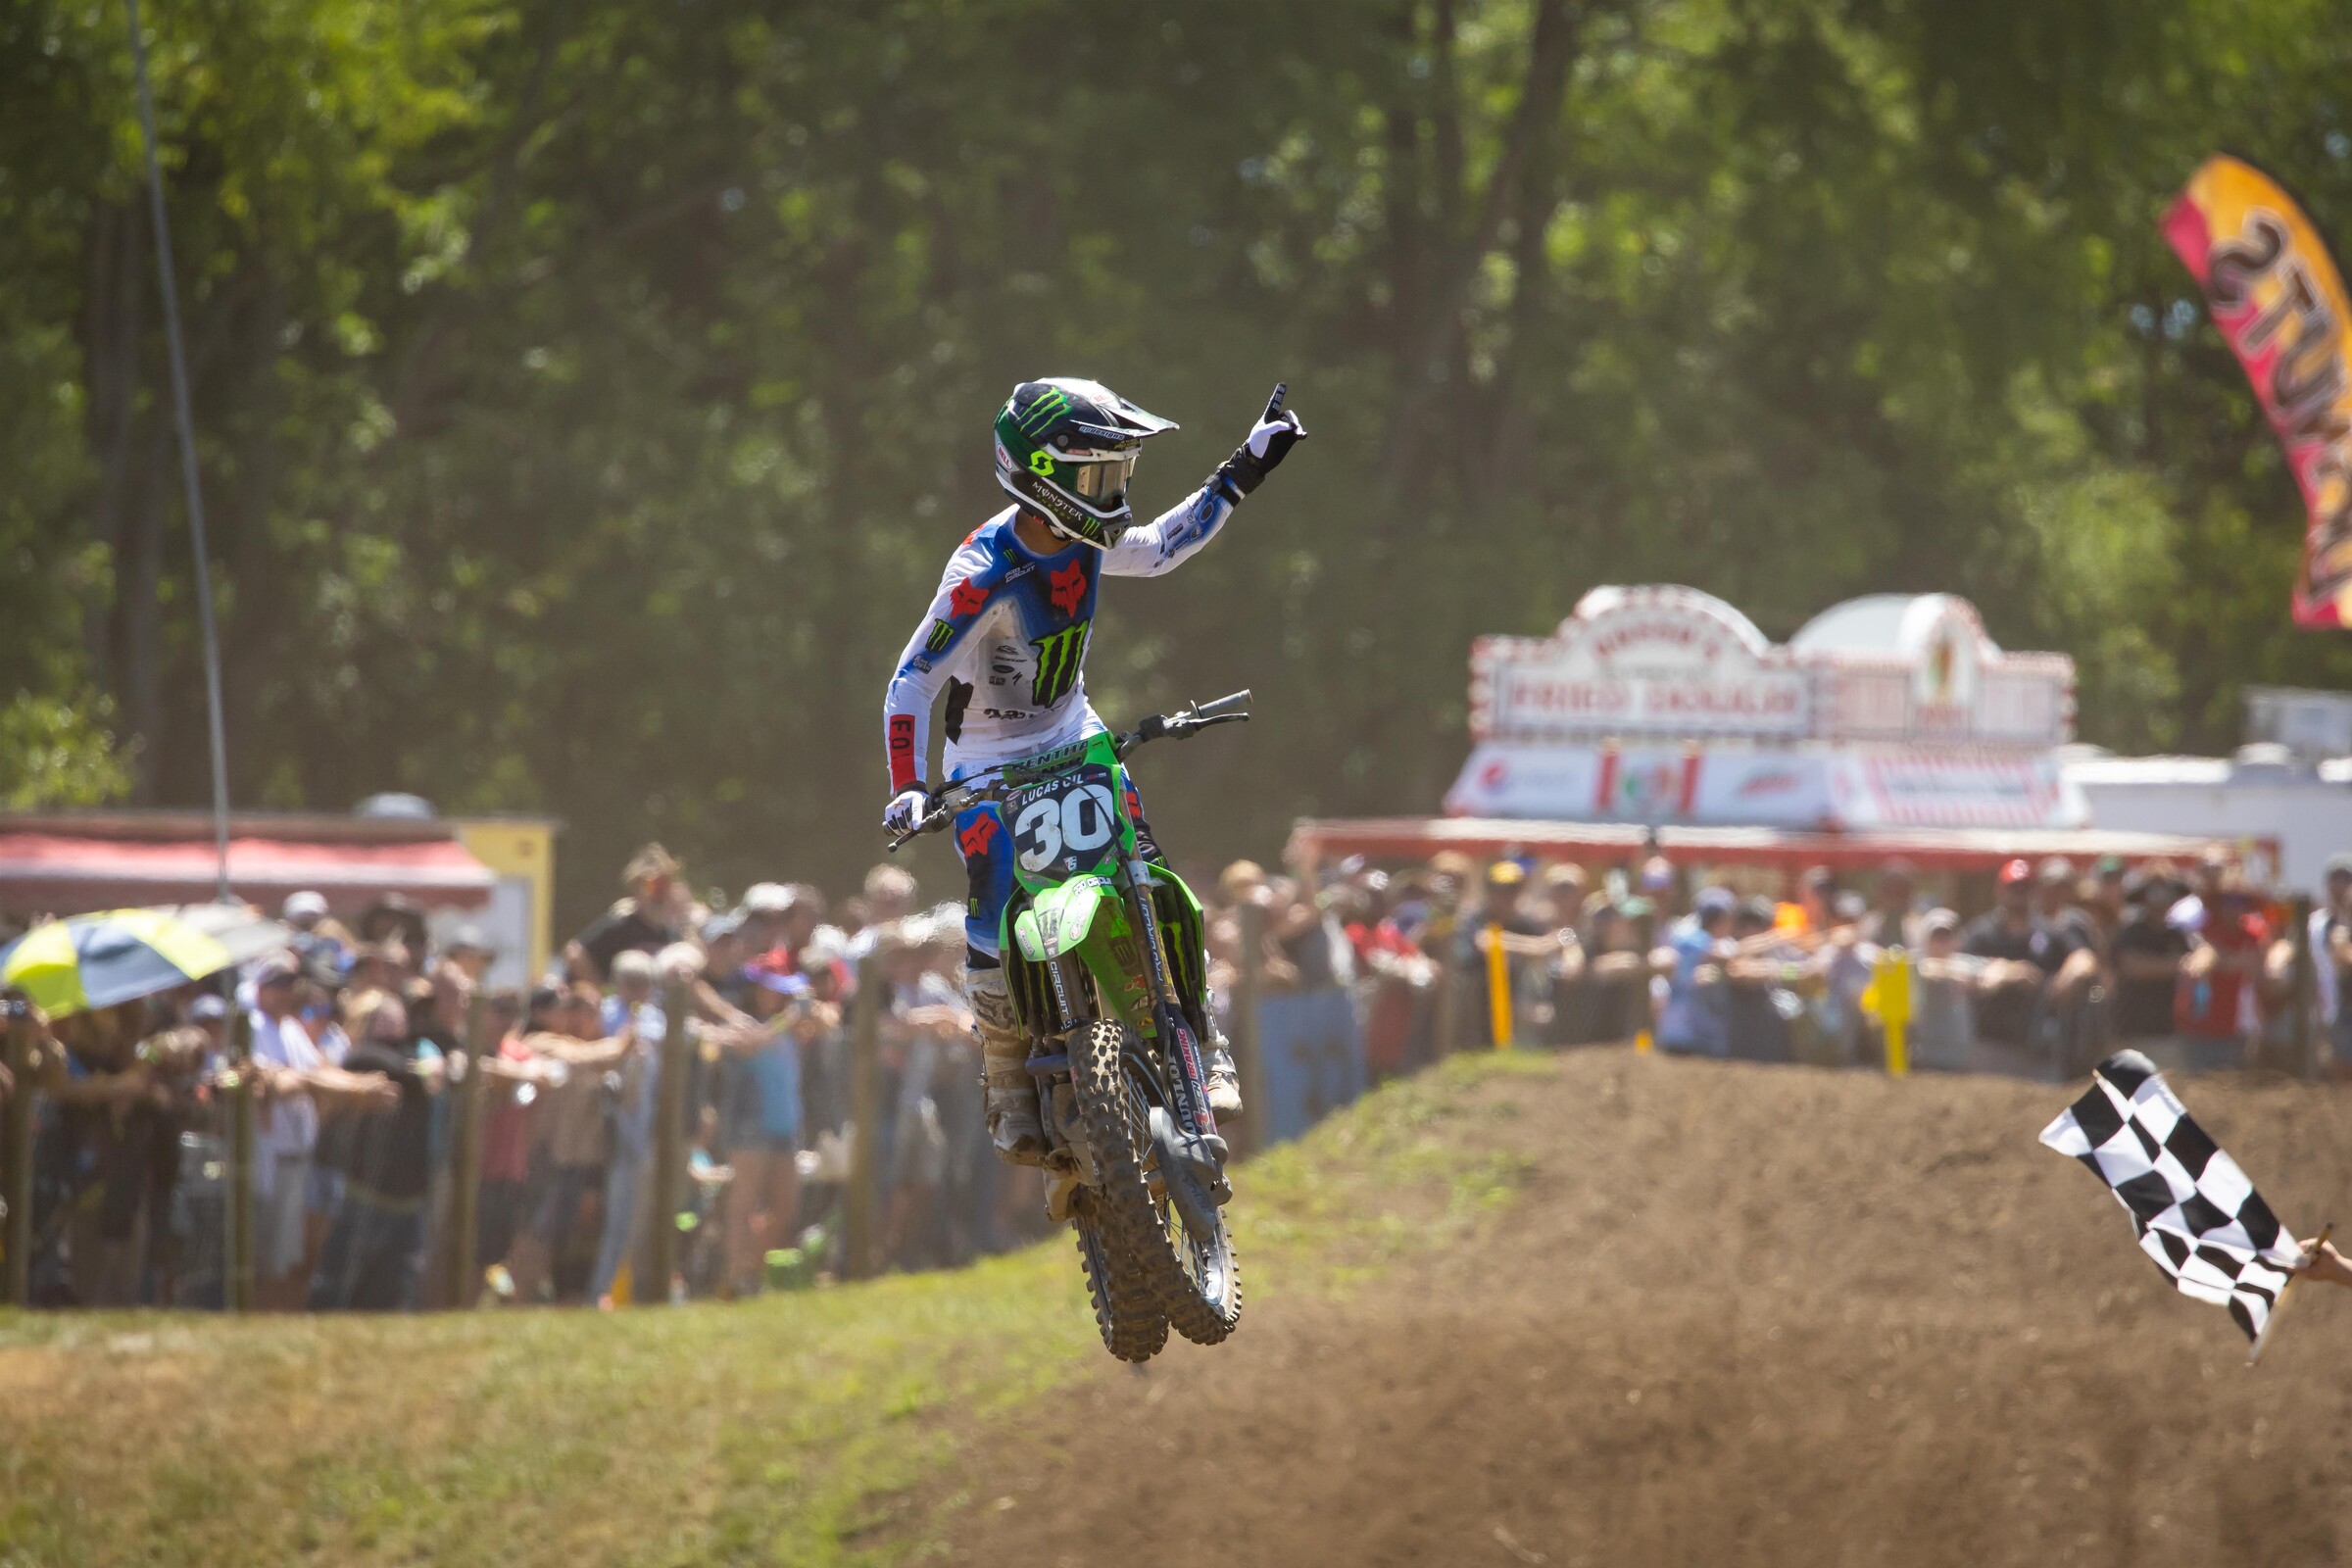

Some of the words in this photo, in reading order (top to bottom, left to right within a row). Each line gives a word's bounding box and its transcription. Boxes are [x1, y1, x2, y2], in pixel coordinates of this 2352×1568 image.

[1032, 481, 1083, 520] MONSTER
[1022, 779, 1059, 806] LUCAS
[1062, 773, 1084, 788] OIL
[1014, 784, 1115, 872] 30
[1050, 960, 1069, 1016] CIRCUIT
[1176, 1027, 1199, 1080] BRAKING
